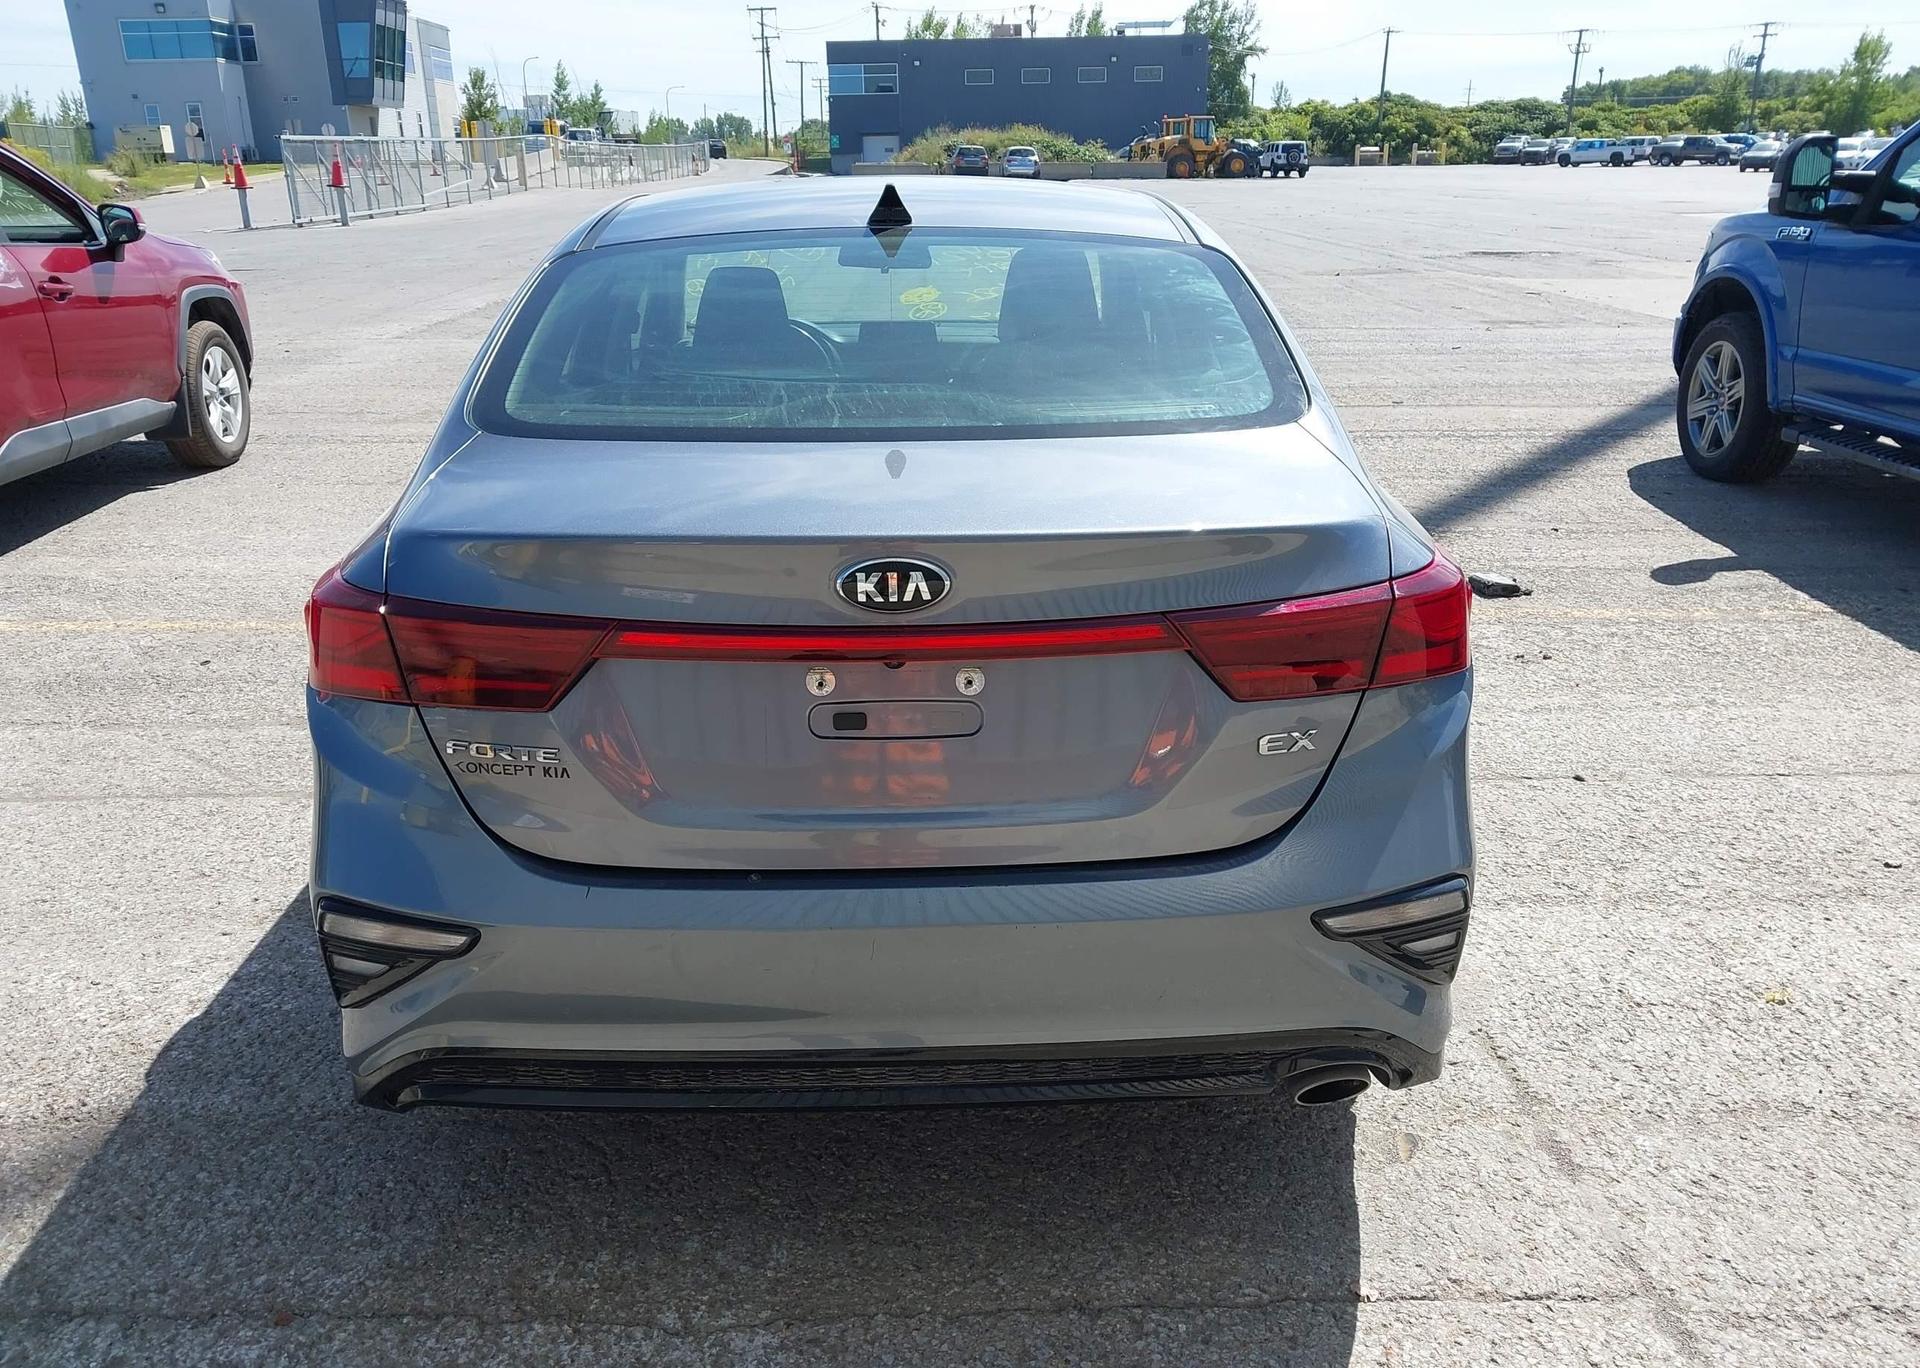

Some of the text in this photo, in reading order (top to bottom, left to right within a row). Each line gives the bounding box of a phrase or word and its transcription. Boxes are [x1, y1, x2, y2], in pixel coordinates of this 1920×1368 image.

[855, 571, 932, 602] KIA
[446, 740, 560, 763] FORTE
[1259, 729, 1318, 755] EX
[543, 766, 571, 779] KIA
